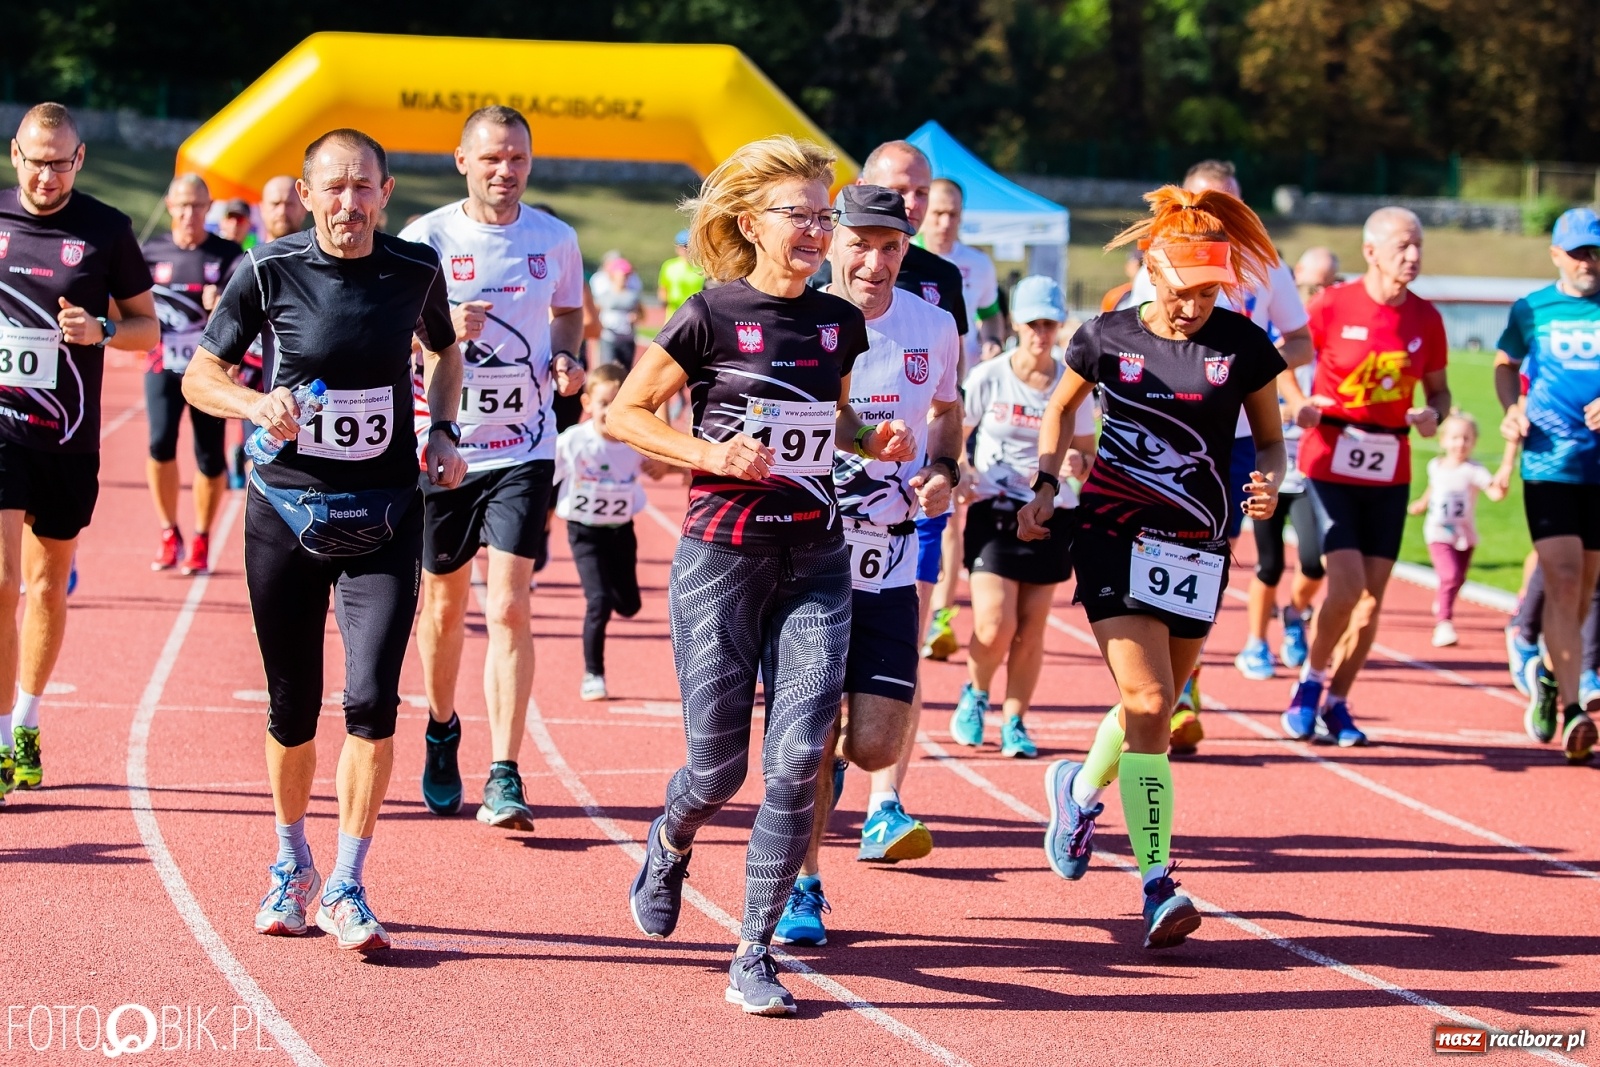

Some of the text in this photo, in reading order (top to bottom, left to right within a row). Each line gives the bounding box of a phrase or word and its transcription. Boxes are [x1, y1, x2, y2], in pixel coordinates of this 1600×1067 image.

[399, 90, 499, 113] MIASTO
[1118, 351, 1145, 359] POLSKA
[333, 394, 391, 406] www.personalbest.pl
[461, 386, 524, 414] 154
[784, 409, 835, 418] www.personalbest.pl
[863, 410, 895, 420] TorKol
[305, 413, 388, 448] 193
[751, 426, 832, 462] 197
[1348, 449, 1385, 472] 92
[329, 507, 369, 519] Reebok
[573, 495, 628, 516] 222
[1147, 566, 1199, 605] 94
